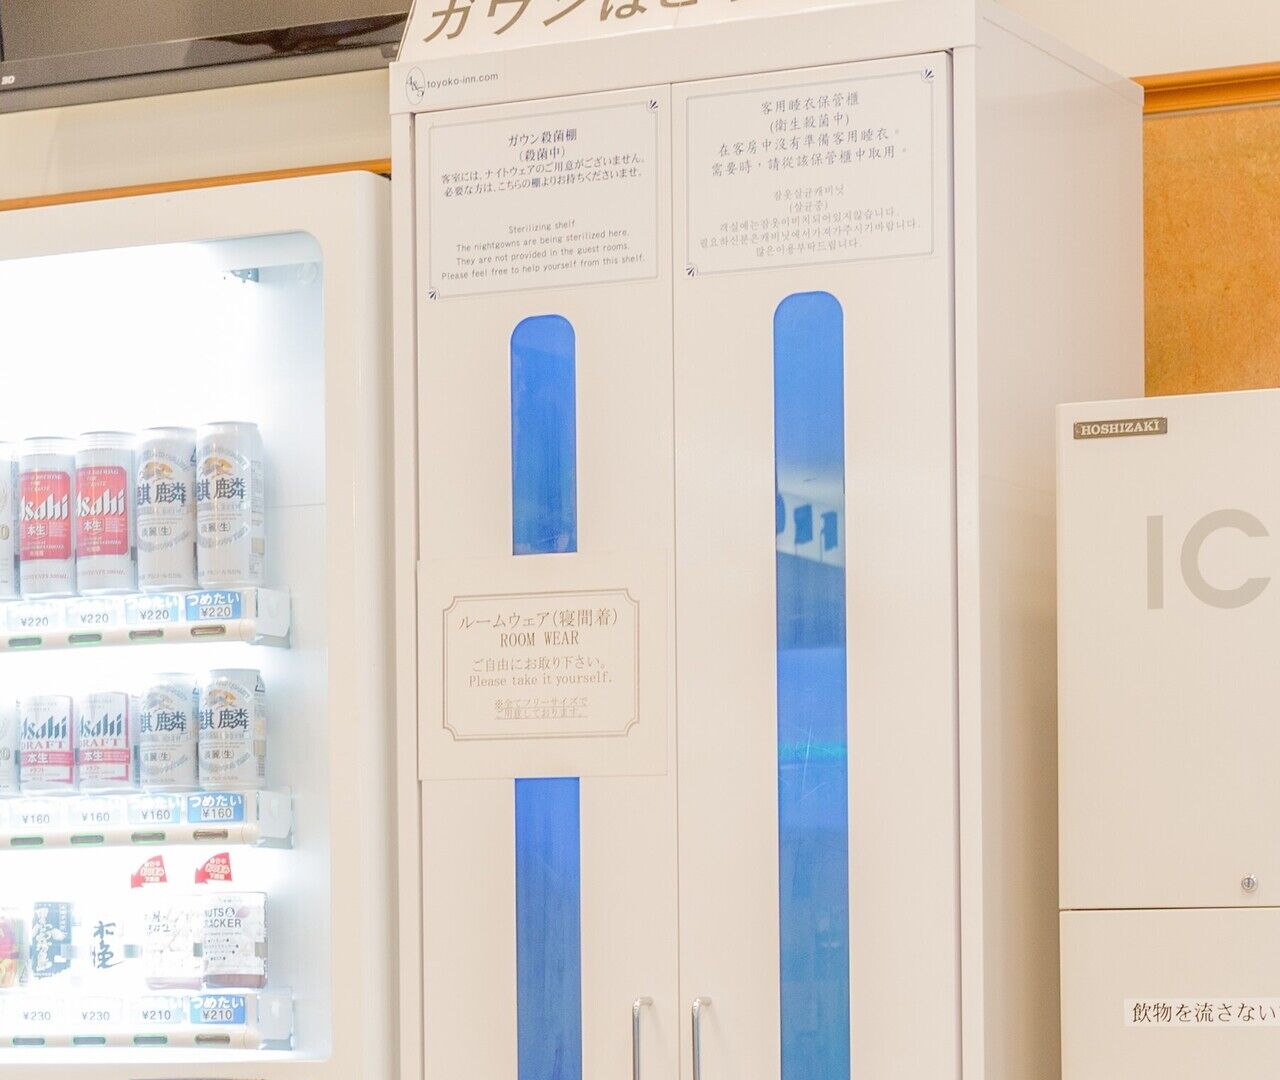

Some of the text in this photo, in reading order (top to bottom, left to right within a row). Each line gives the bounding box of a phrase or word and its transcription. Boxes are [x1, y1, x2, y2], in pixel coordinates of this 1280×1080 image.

[427, 72, 498, 89] toyoko-inn.com
[508, 128, 577, 147] ガウン殺菌棚
[508, 219, 576, 234] Sterilizing shelf
[456, 244, 471, 252] The
[474, 240, 520, 251] nightgowns
[524, 237, 537, 246] are
[540, 235, 562, 245] being
[566, 230, 606, 242] sterilized
[456, 257, 475, 266] They
[479, 255, 492, 264] are
[495, 254, 508, 262] not
[511, 250, 547, 262] provided
[550, 248, 557, 256] in
[561, 247, 573, 255] the
[577, 245, 599, 255] guest
[441, 271, 468, 280] Please
[471, 269, 488, 278] feel
[491, 267, 508, 276] free
[511, 266, 520, 274] to
[522, 263, 540, 273] help
[543, 260, 577, 272] yourself
[580, 258, 600, 267] from
[603, 256, 618, 265] this
[1080, 419, 1160, 436] HOSHIZAKI
[187, 592, 240, 605] つめたい
[500, 630, 580, 648] ROOM WEAR
[472, 655, 606, 673] ご自由にお取り下さい。
[469, 672, 612, 688] Please take it yourself.
[189, 794, 242, 807] つめたい
